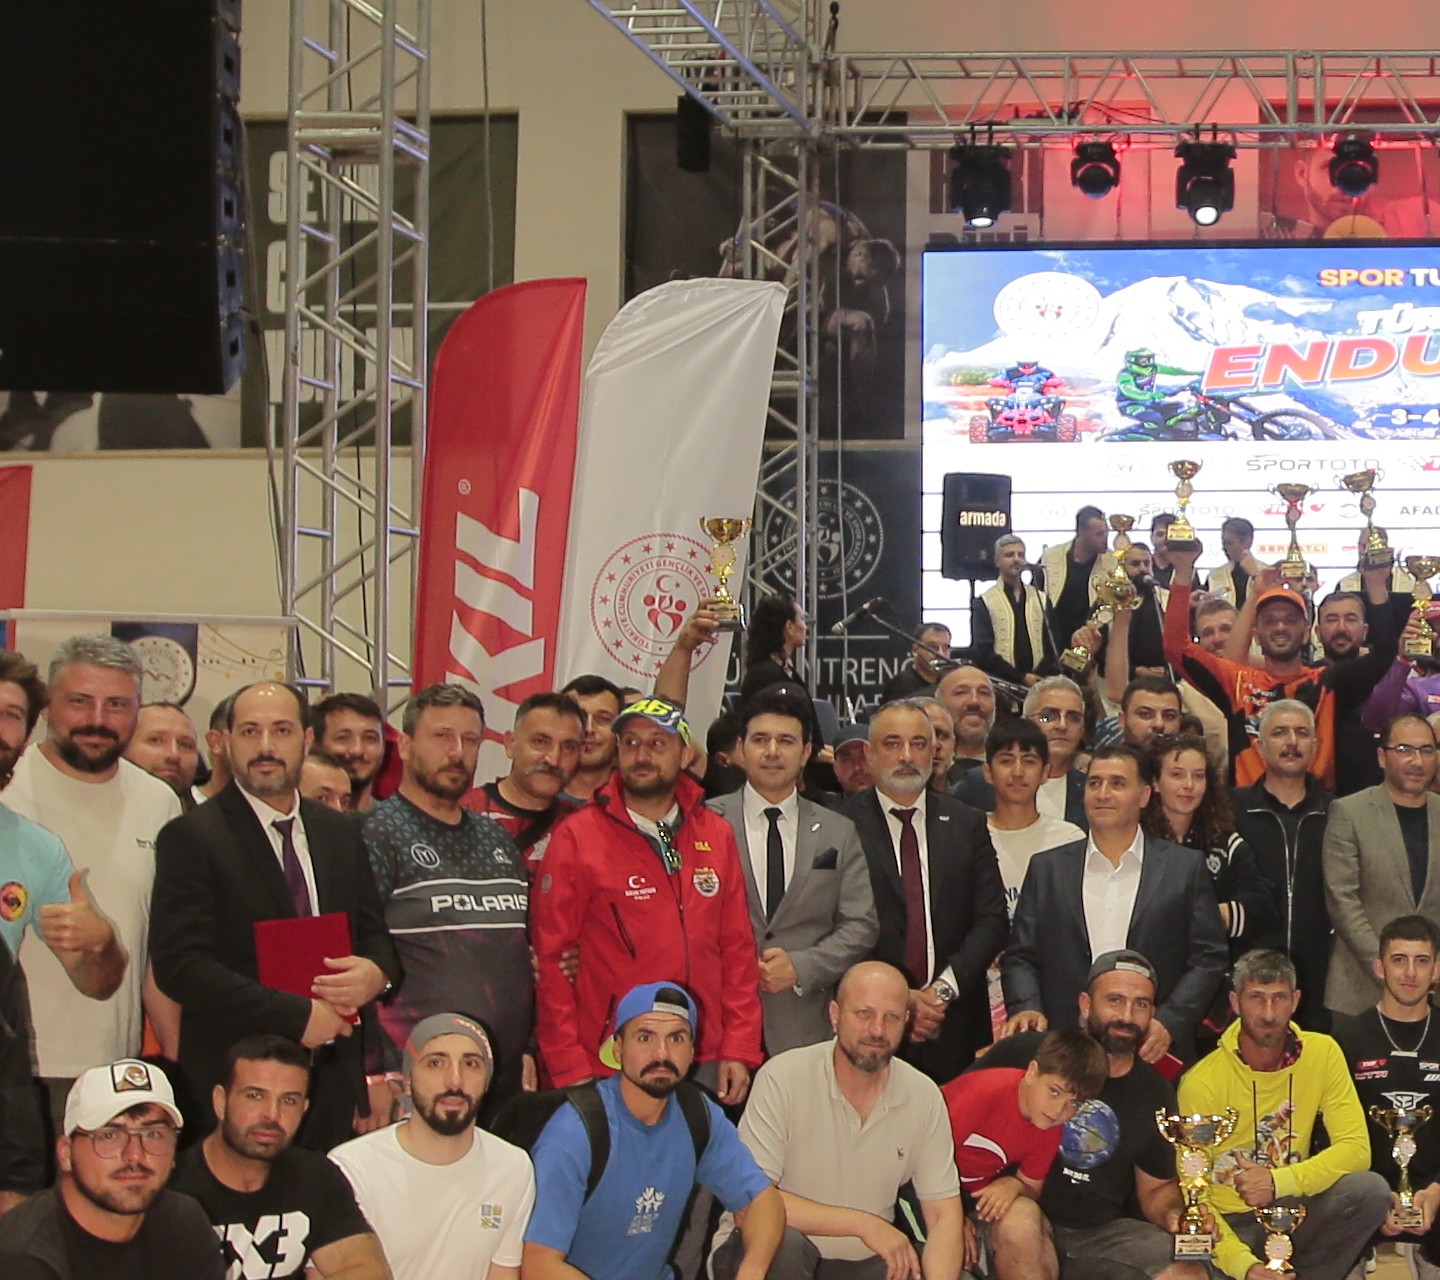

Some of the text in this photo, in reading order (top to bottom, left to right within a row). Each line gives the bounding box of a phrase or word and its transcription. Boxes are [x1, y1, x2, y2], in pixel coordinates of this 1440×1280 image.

[1320, 269, 1404, 288] SPOR
[1246, 458, 1380, 471] SPORTOTO
[958, 507, 1008, 527] armada
[617, 560, 654, 617] CUMHURİYETİ
[656, 558, 694, 580] GENÇLİK
[431, 893, 529, 913] POLARIS
